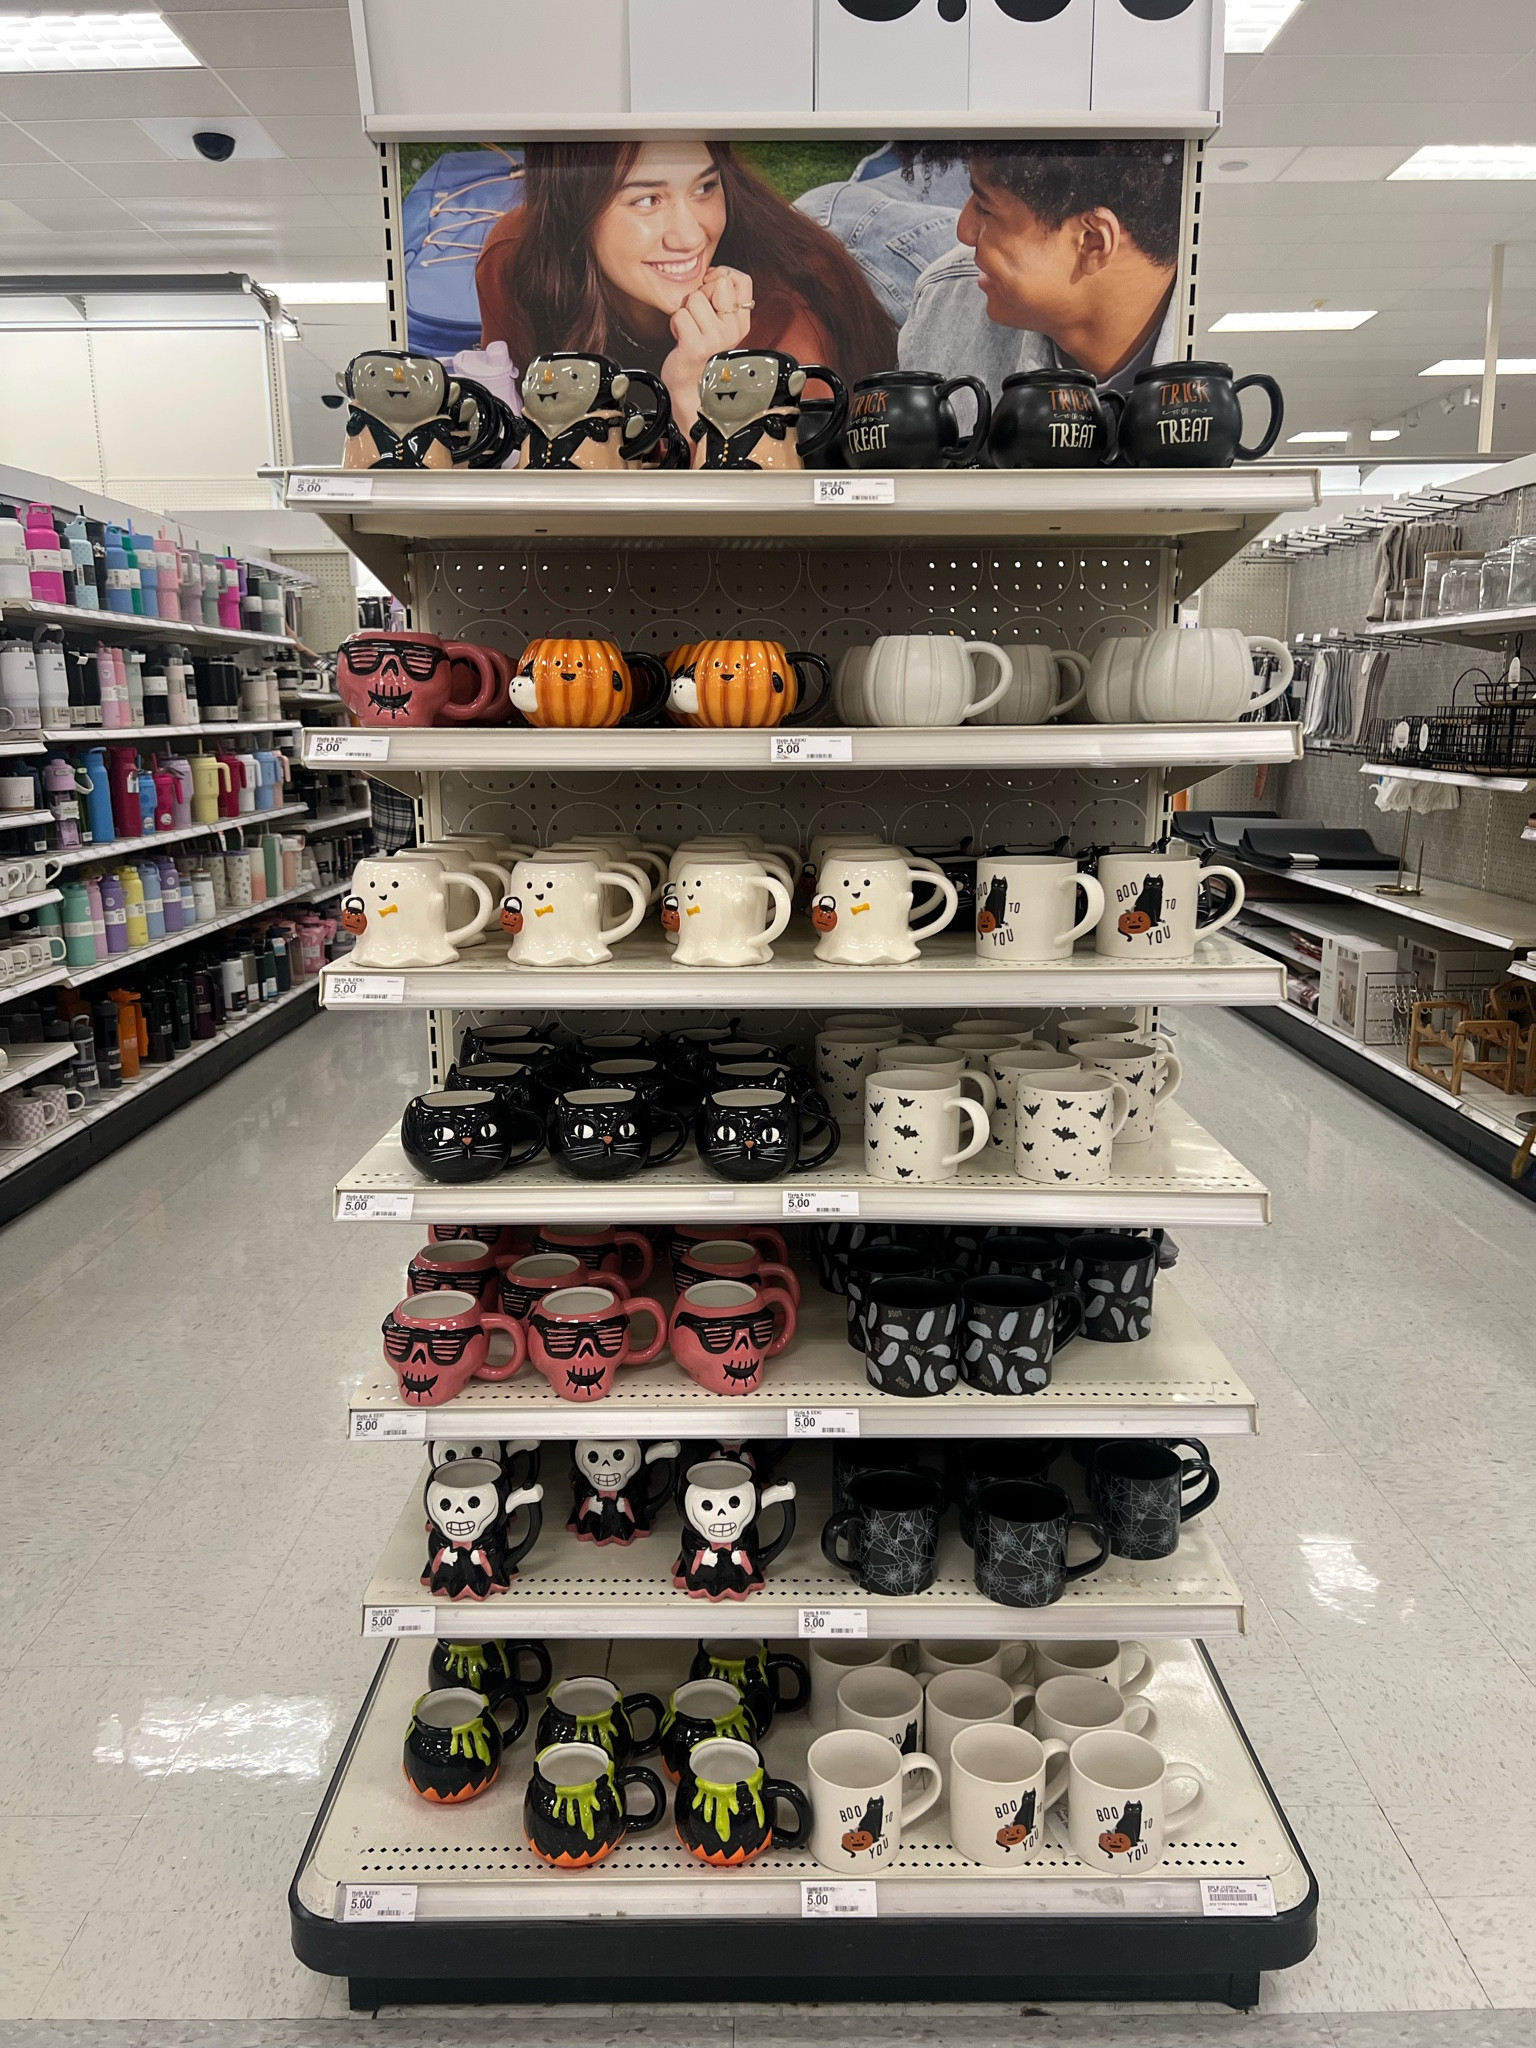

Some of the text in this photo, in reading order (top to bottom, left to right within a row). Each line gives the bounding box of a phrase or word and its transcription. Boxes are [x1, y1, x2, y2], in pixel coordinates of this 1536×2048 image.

[1160, 380, 1210, 406] TRICK
[850, 389, 890, 417] TRICK
[1048, 389, 1093, 412] TRICK
[1048, 423, 1096, 448] TREAT
[1156, 417, 1213, 444] TREAT
[847, 424, 889, 454] TREAT
[297, 484, 322, 493] 5.00
[820, 487, 844, 496] 5.00
[316, 743, 340, 752] 5.00
[776, 744, 800, 754] 5.00
[1116, 881, 1138, 902] BOO
[1008, 902, 1021, 914] TO
[1165, 898, 1177, 910] TO
[992, 928, 1014, 946] YOU
[1146, 925, 1171, 946] YOU
[333, 984, 357, 994] 5.00
[345, 1201, 367, 1211] 5.00
[788, 1199, 810, 1208] 5.00
[356, 1421, 378, 1431] 5.00
[794, 1417, 816, 1427] 5.00
[371, 1616, 393, 1626] 5.00
[804, 1618, 825, 1628] 5.00
[839, 1805, 862, 1823] BOO
[994, 1800, 1018, 1819] BOO
[1096, 1806, 1119, 1822] BOO
[885, 1811, 894, 1824] TO
[1143, 1818, 1154, 1829] TO
[1022, 1828, 1039, 1852] YOU
[868, 1837, 889, 1860] YOU
[1126, 1843, 1149, 1864] YOU
[350, 1898, 372, 1909] 5.00
[807, 1894, 829, 1905] 5.00
